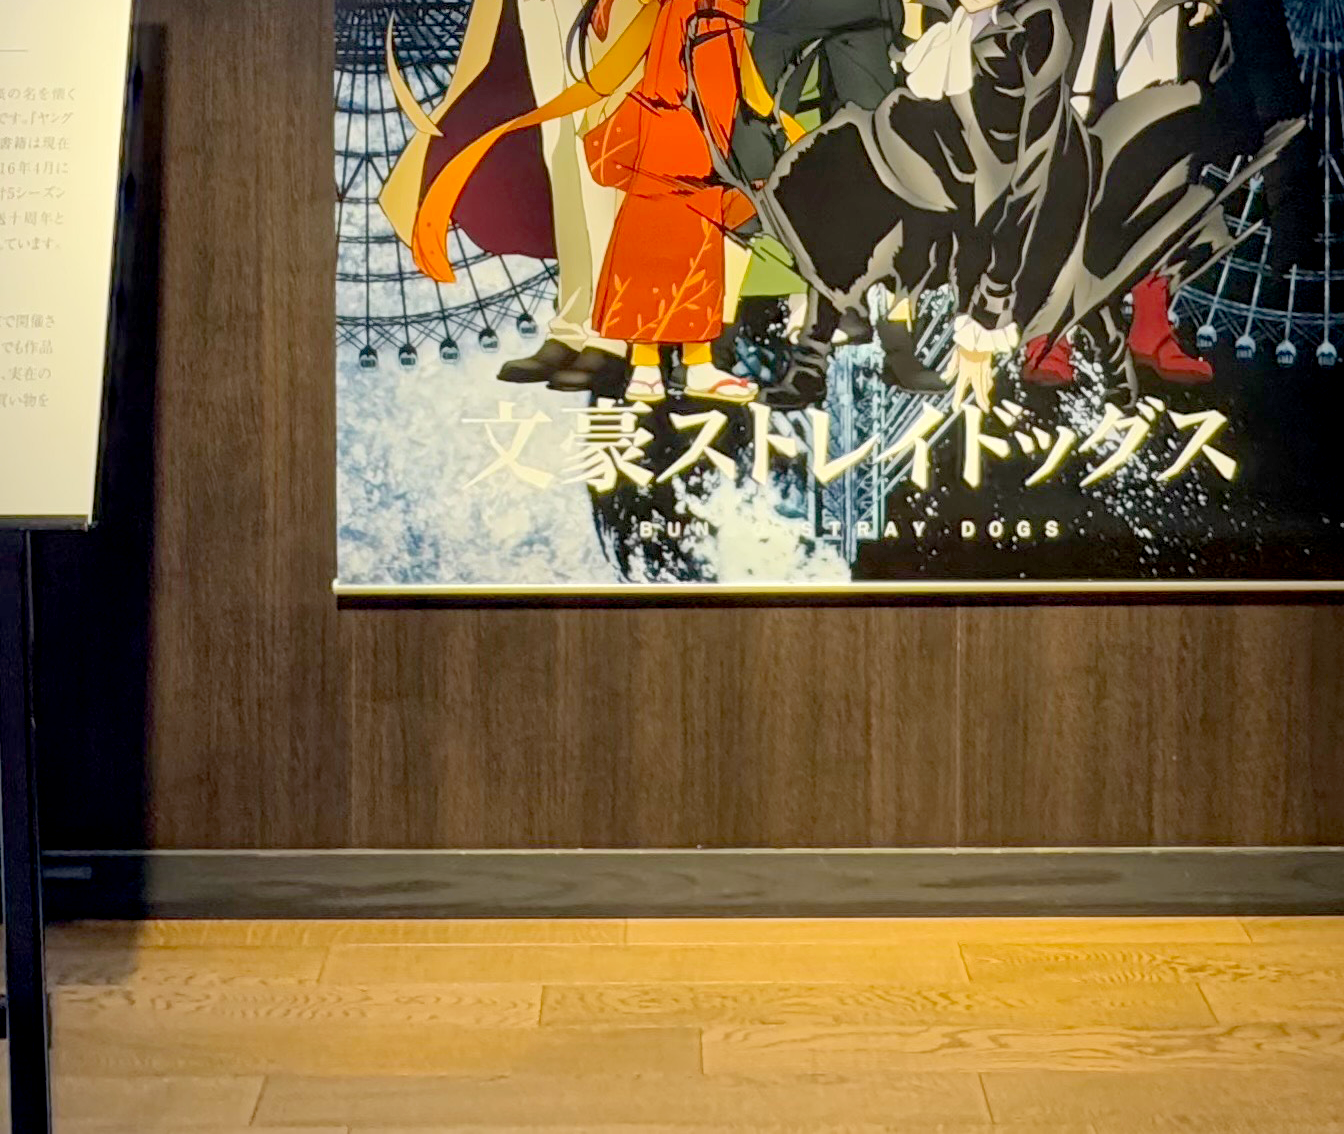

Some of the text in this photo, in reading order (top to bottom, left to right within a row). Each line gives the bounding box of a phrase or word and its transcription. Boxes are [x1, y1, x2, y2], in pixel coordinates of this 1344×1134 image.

[460, 401, 1238, 490] 文豪ストレイドッグス
[960, 520, 1061, 538] DOGS
